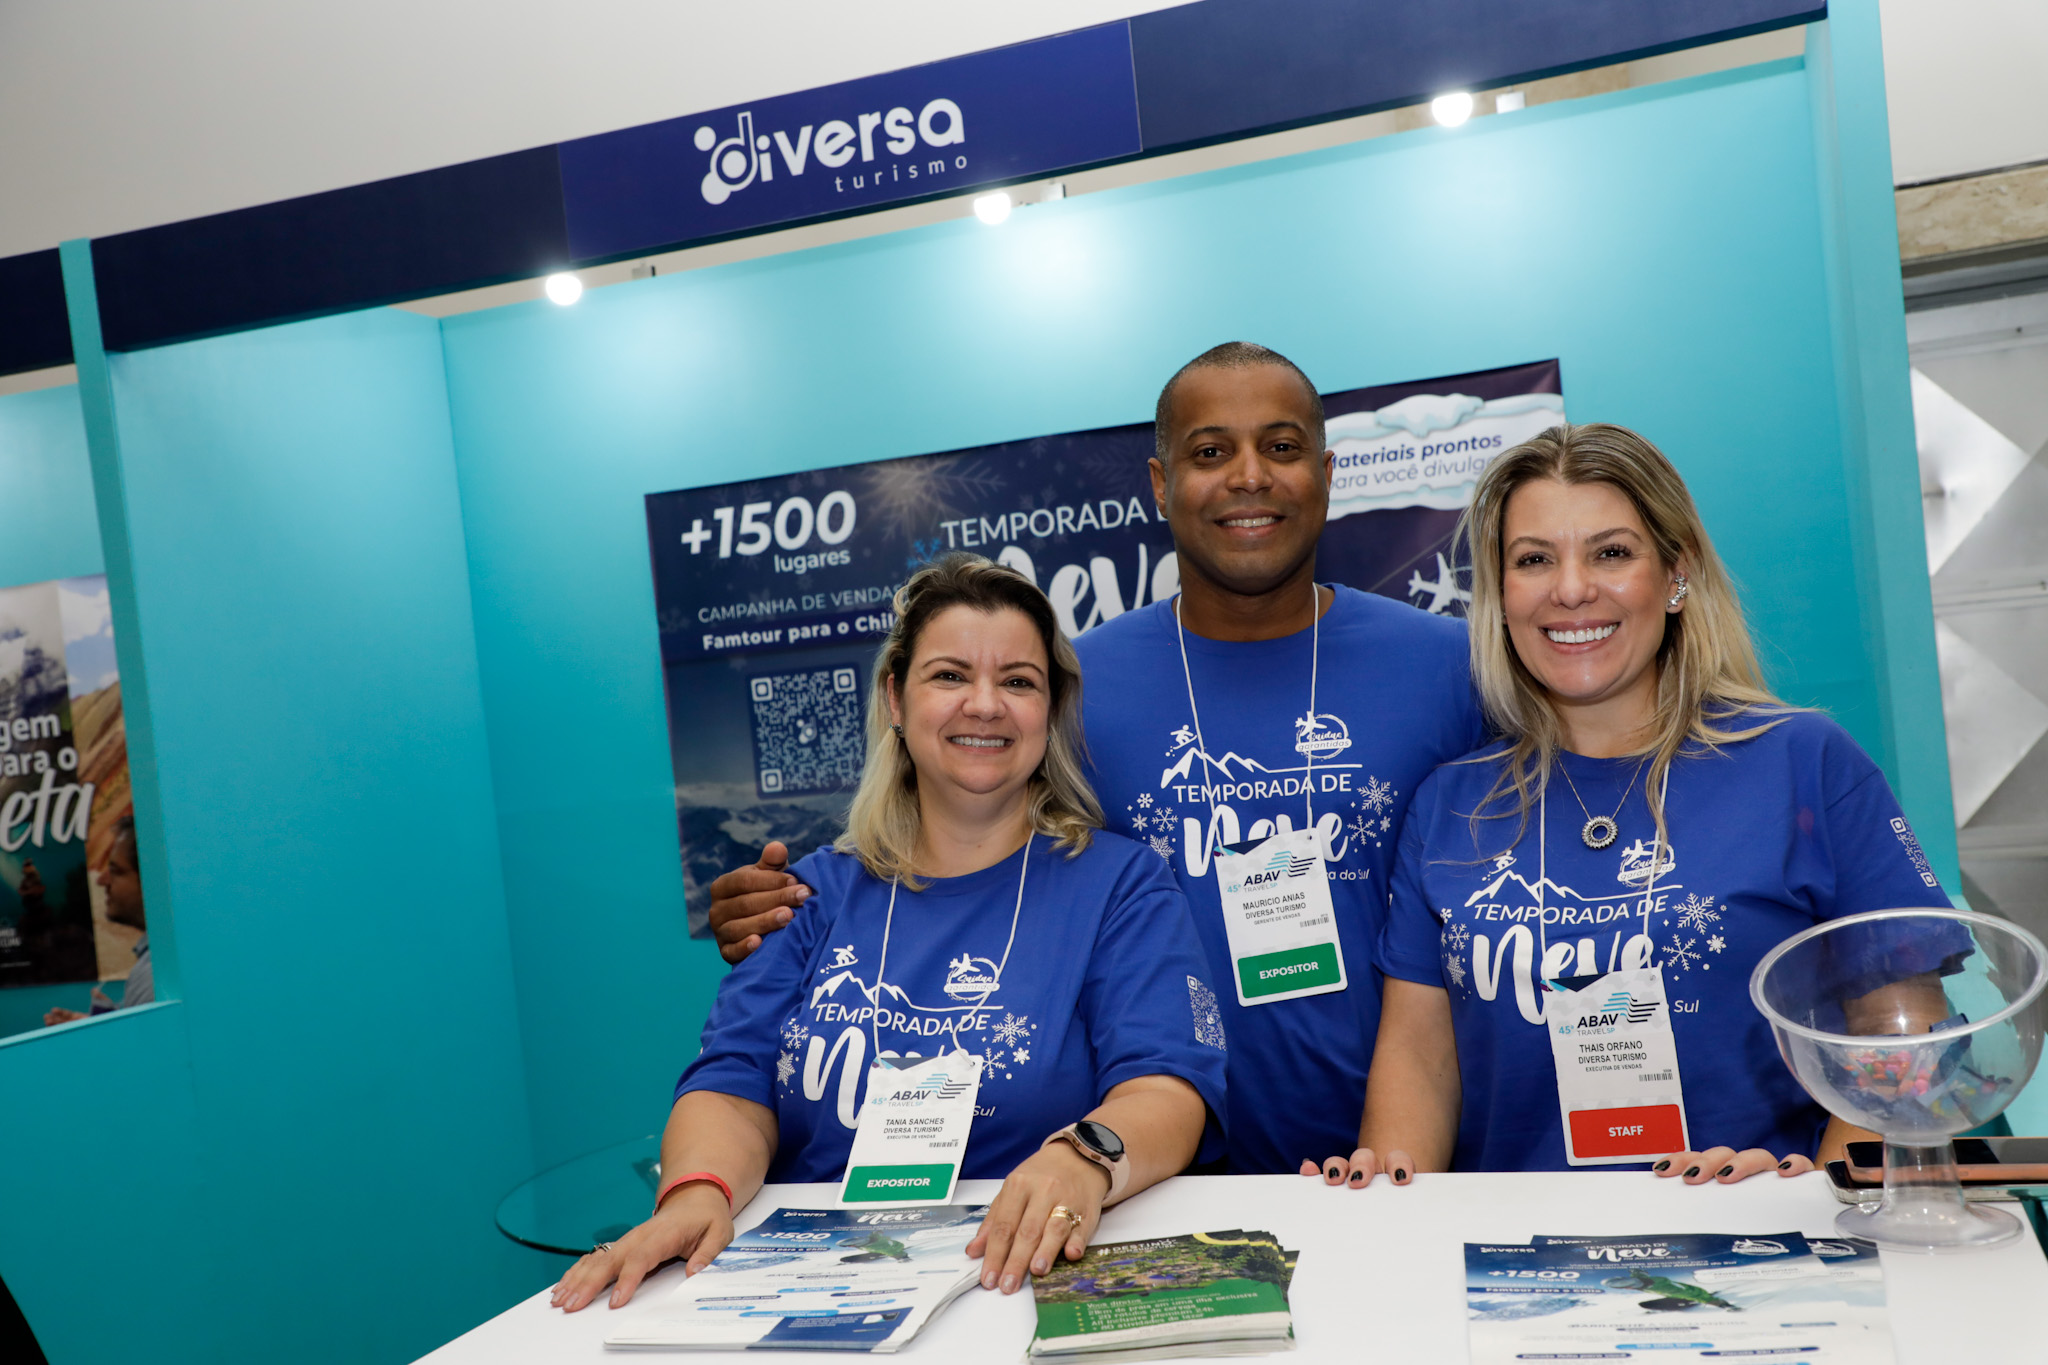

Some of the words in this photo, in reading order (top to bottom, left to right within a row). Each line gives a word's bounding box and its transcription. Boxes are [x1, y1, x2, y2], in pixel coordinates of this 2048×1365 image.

[711, 98, 965, 192] diversa
[835, 155, 967, 192] turismo
[1421, 435, 1502, 461] prontos
[1331, 474, 1368, 490] ara
[1374, 463, 1418, 484] você
[1424, 456, 1494, 478] divulg
[681, 490, 857, 559] +1500
[940, 496, 1149, 548] TEMPORADA
[774, 549, 851, 574] lugares
[698, 598, 798, 623] CAMPANHA
[802, 593, 826, 611] DE
[702, 629, 782, 650] Famtour
[788, 621, 831, 644] para
[837, 621, 850, 635] o
[855, 612, 898, 632] Chil
[0, 750, 50, 777] ara
[57, 746, 78, 771] o
[1172, 777, 1316, 803] TEMPORADA
[1321, 773, 1352, 793] DE
[1244, 870, 1281, 887] ABAV
[1339, 869, 1356, 881] do
[1243, 896, 1280, 910] MAURICIO
[1282, 892, 1305, 903] ANIAS
[1474, 903, 1630, 925] TEMPORADA
[1636, 895, 1669, 916] DE
[1245, 908, 1274, 920] DIVERSA
[1276, 902, 1306, 914] TURISMO
[1259, 961, 1319, 980] EXPOSITOR
[1673, 1000, 1699, 1013] Sul
[815, 1003, 953, 1036] TEMPORADA
[959, 1014, 990, 1032] DE
[1577, 1013, 1619, 1029] ABAV
[1579, 1043, 1605, 1053] THAIS
[1606, 1040, 1643, 1052] ORFANO
[1578, 1055, 1611, 1065] DIVERSA
[1612, 1052, 1647, 1062] TURISMO
[890, 1090, 932, 1101] ABAV
[886, 1118, 907, 1126] TANIA
[908, 1117, 945, 1126] SANCHES
[1608, 1125, 1644, 1137] STAFF
[866, 1177, 931, 1188] EXPOSITOR
[857, 1211, 922, 1225] Neve
[760, 1232, 831, 1240] +1500
[1587, 1247, 1671, 1262] Neve
[1488, 1270, 1580, 1279] +1500
